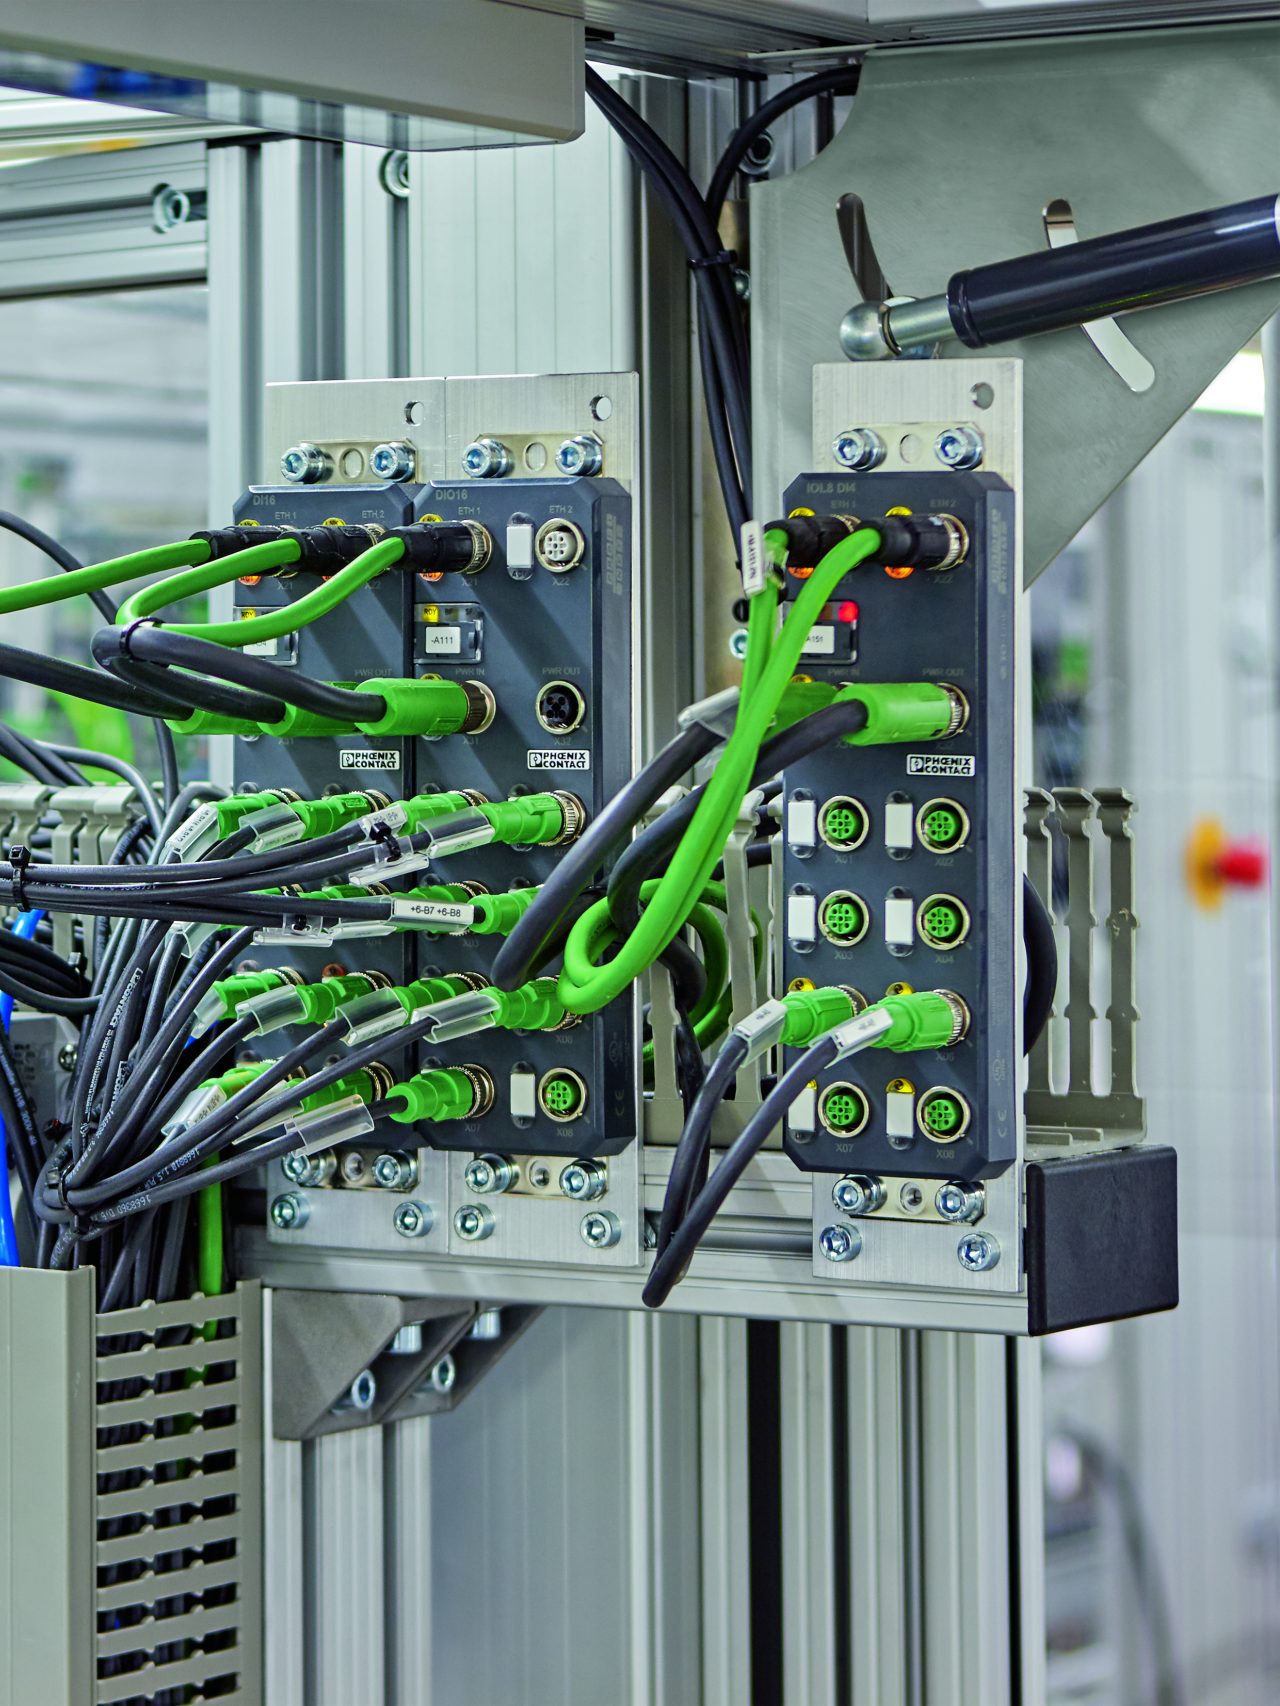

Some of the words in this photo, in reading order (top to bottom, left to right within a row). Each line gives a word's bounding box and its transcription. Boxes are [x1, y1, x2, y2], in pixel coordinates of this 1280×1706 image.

[435, 489, 469, 500] DIO16
[253, 495, 276, 506] DI16
[458, 506, 476, 515] ETH
[549, 505, 566, 514] ETH
[566, 505, 573, 513] 2
[275, 512, 291, 520] ETH
[361, 510, 378, 519] ETH
[277, 582, 293, 590] X21
[552, 577, 569, 586] X22
[424, 607, 437, 616] RDY
[431, 636, 454, 645] -A111
[373, 668, 392, 677] OUT
[455, 668, 475, 676] PWR
[476, 668, 485, 676] IN
[541, 667, 562, 676] PWR
[562, 667, 581, 676] OUT
[354, 760, 397, 769] CONTACT
[543, 760, 587, 769] CONTACT
[924, 766, 971, 775] CONTACT
[410, 904, 435, 915] +6-B7
[437, 906, 462, 917] +6-B8
[835, 1143, 854, 1153] X07
[936, 1150, 956, 1159] X08
